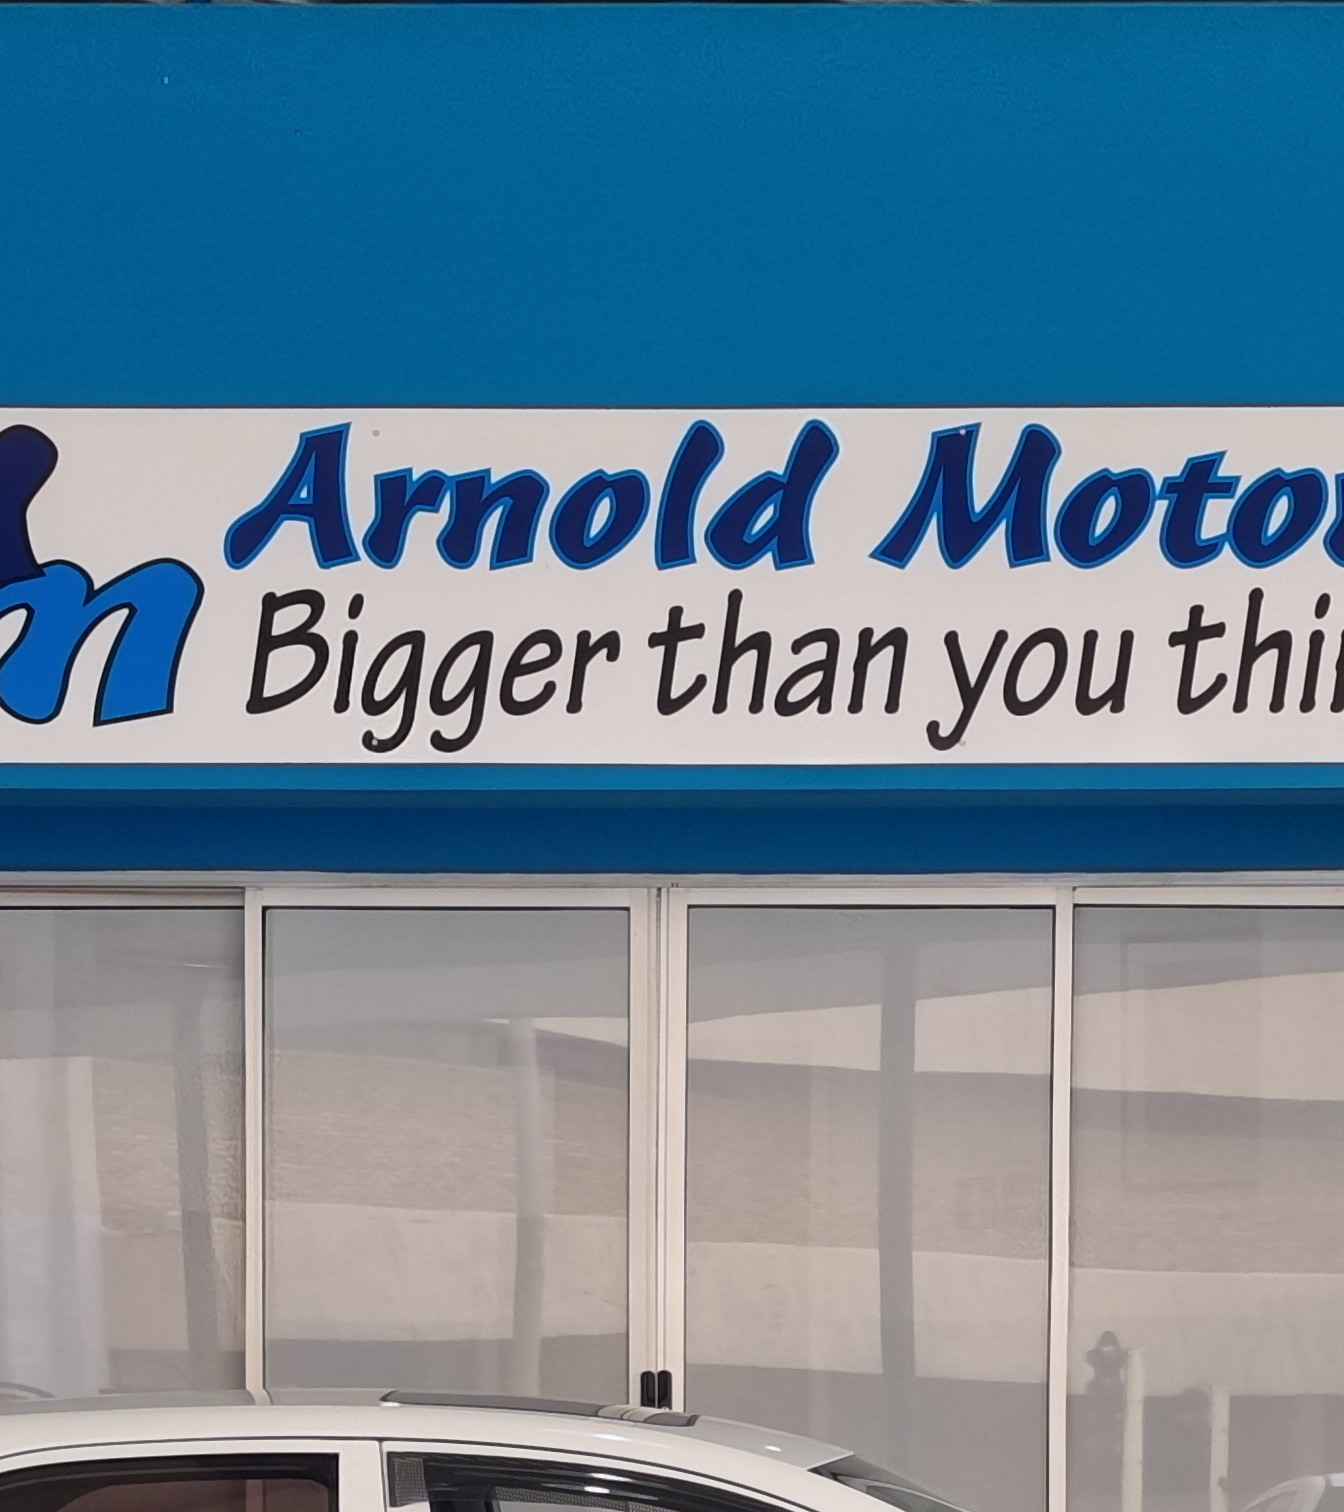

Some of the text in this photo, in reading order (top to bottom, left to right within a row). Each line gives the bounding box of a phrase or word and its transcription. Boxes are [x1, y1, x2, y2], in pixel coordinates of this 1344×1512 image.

[223, 419, 840, 571] Arnold
[246, 589, 621, 753] Bigger
[647, 588, 908, 717] than
[926, 628, 1134, 752] you
